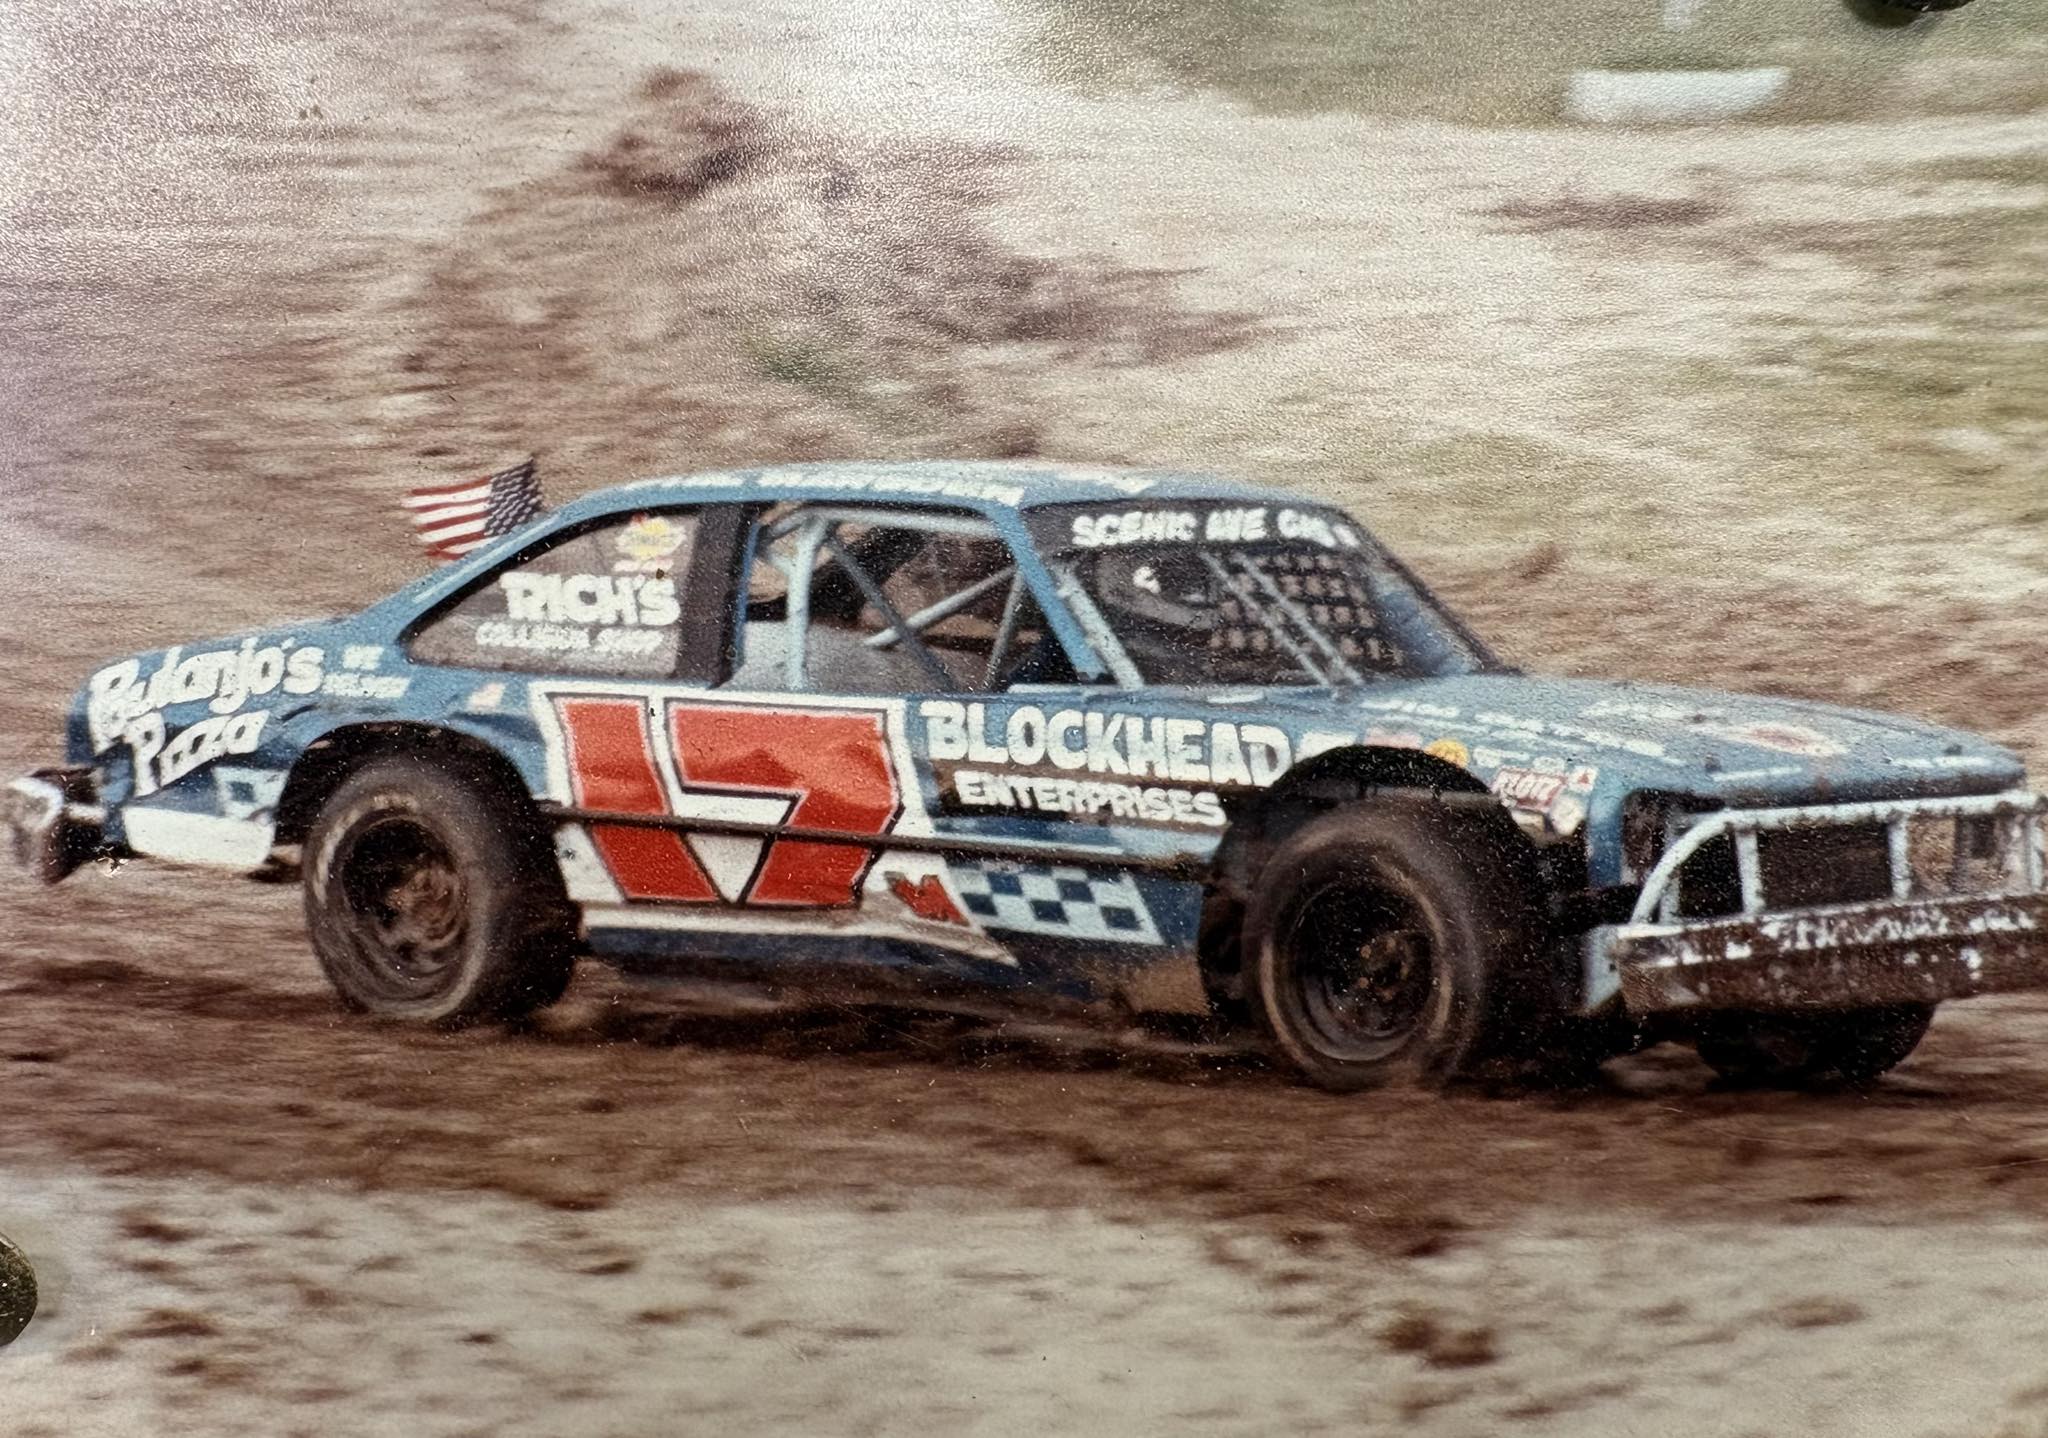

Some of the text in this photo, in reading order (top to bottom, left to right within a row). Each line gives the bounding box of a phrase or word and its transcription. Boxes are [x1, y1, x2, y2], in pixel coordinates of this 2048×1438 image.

[500, 571, 682, 626] RICH'S
[919, 700, 1294, 788] BLOCKHEAD
[546, 692, 904, 909] 17
[954, 770, 1228, 826] ENTERPRISES
